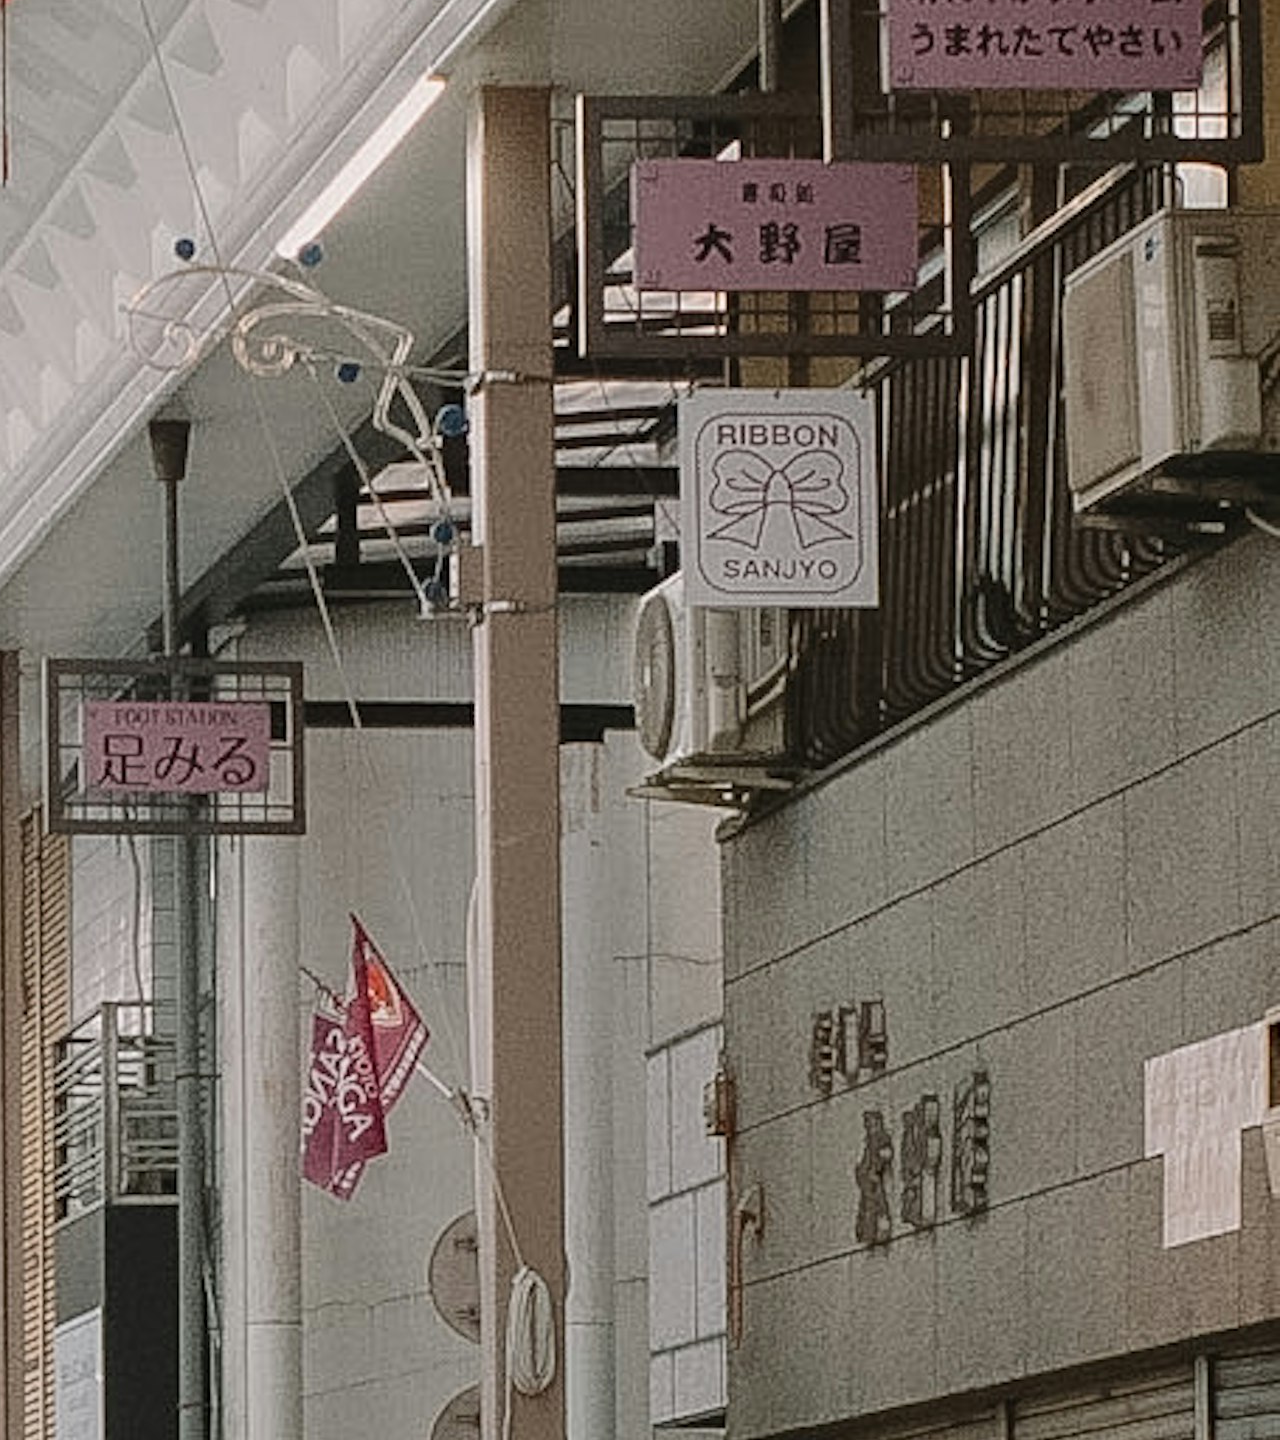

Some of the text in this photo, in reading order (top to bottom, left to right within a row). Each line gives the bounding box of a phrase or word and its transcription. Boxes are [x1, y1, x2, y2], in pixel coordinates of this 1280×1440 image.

[910, 23, 1183, 58] うまれたてやさい
[693, 221, 864, 266] 大野屋
[716, 423, 840, 447] RIBBON
[722, 559, 839, 580] SANJYO
[96, 733, 257, 786] 足みる
